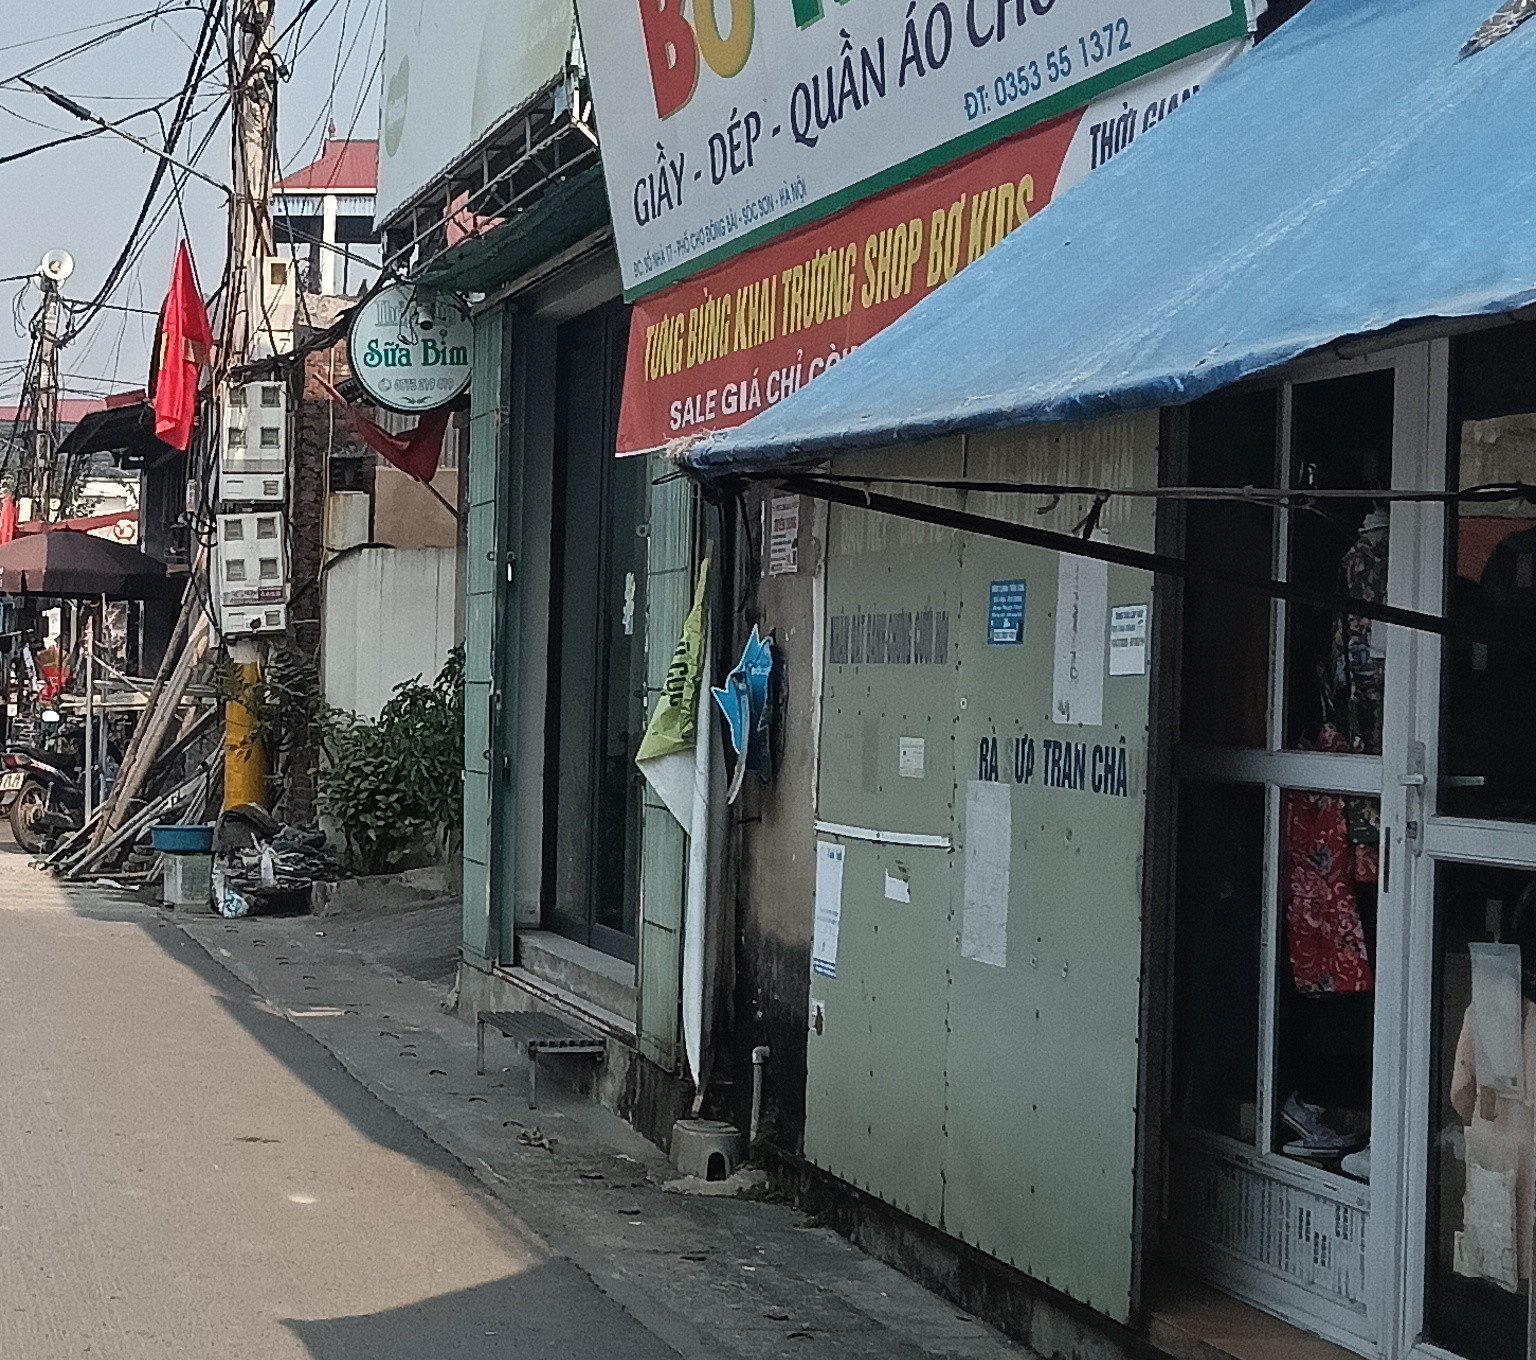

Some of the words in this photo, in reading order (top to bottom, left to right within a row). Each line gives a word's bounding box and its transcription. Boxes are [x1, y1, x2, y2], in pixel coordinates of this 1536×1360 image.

[633, 141, 685, 226] GIẦY
[708, 107, 761, 185] DÉP
[790, 28, 886, 148] QUẦN
[898, 0, 953, 88] ÁO
[964, 85, 991, 121] ĐT:
[994, 60, 1042, 107] 0353
[1045, 45, 1072, 83] 55
[1078, 17, 1132, 67] 1372
[1090, 102, 1138, 171] THỜI
[644, 313, 685, 382] TƯNG
[687, 287, 731, 368] BỪNG
[733, 275, 777, 352] KHAI
[781, 242, 857, 336] TRƯƠNG
[861, 218, 923, 309] SHOP
[926, 192, 966, 288] BƠ
[967, 174, 1034, 263] KIDS
[363, 338, 413, 368] Sữa
[421, 329, 468, 367] Bỉm
[669, 389, 717, 431] SALE
[721, 367, 762, 415] GIÁ
[766, 349, 804, 405] CHỈ
